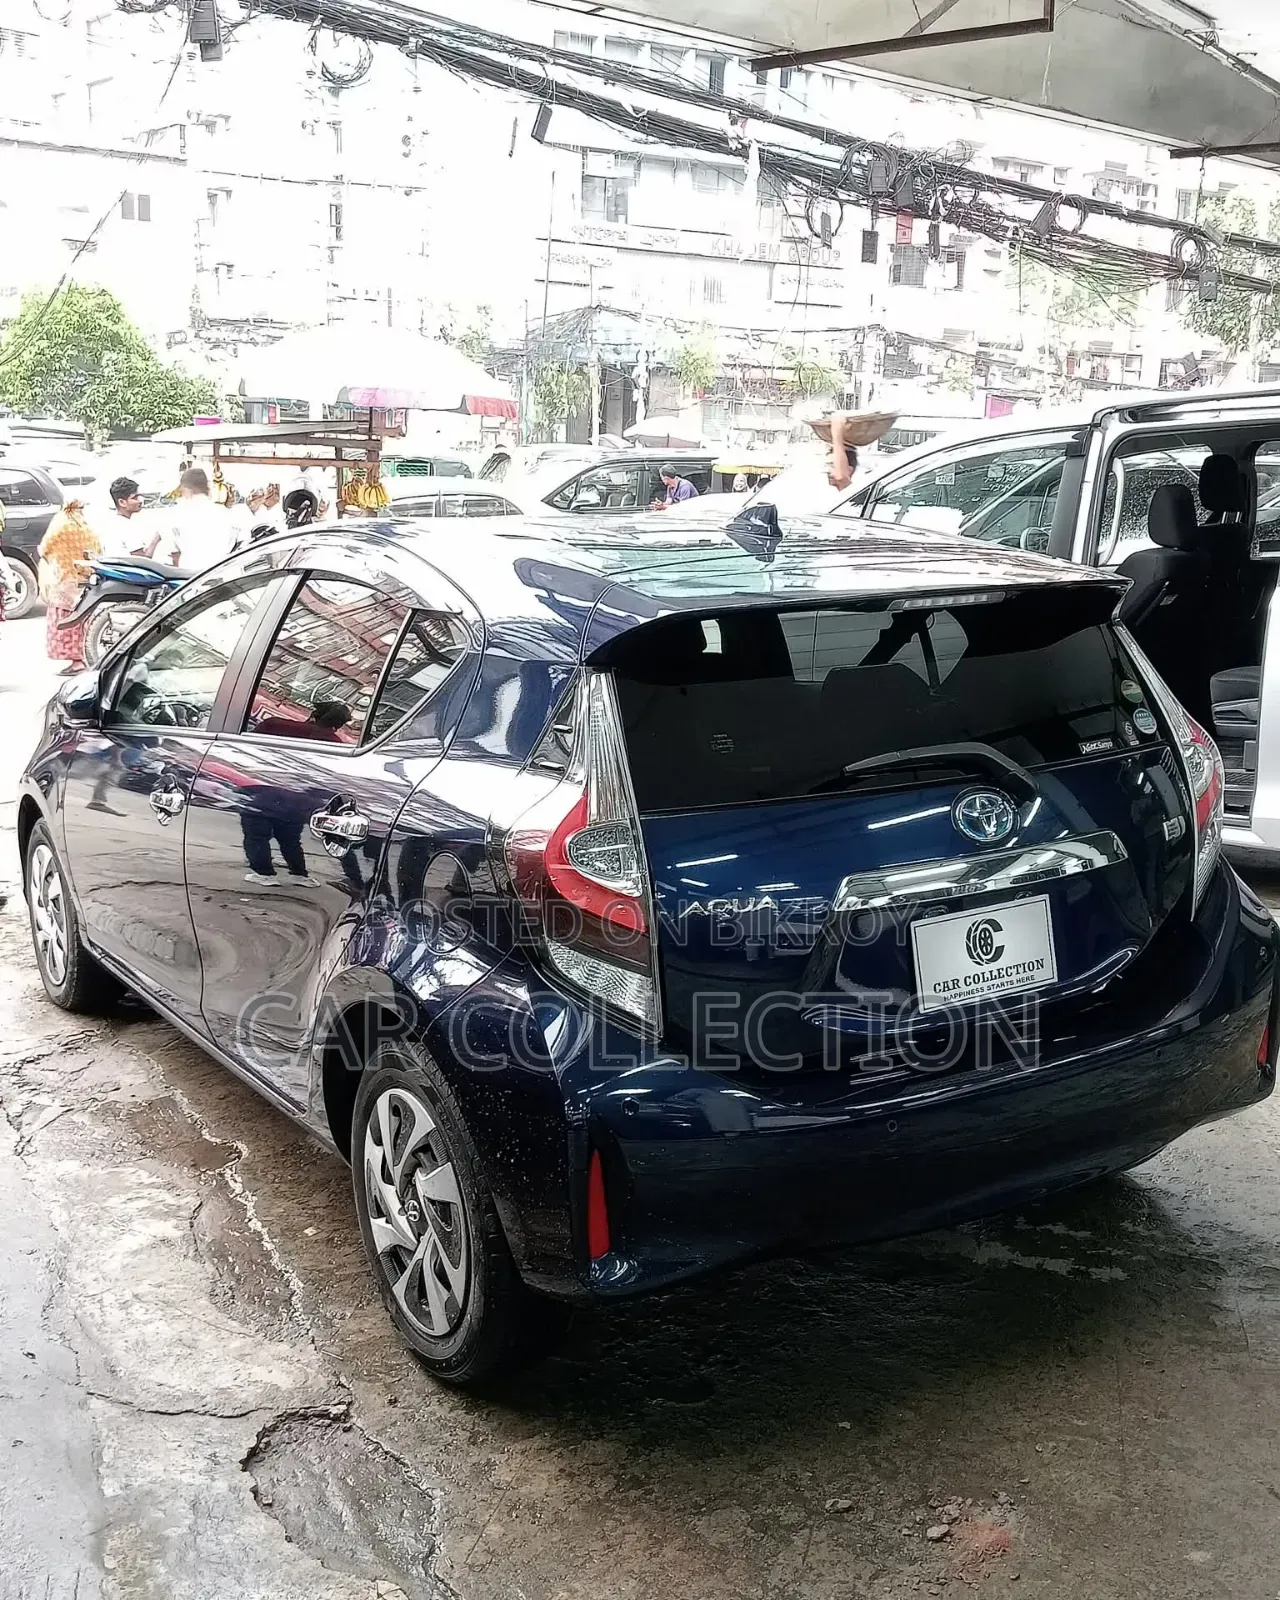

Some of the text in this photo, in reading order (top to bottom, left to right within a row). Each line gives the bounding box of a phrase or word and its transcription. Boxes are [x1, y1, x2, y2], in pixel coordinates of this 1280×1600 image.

[679, 895, 778, 919] AQUA
[933, 958, 1045, 994] CAR COLLECTION
[943, 974, 1036, 1002] HAPPINESS STARTS HERE
